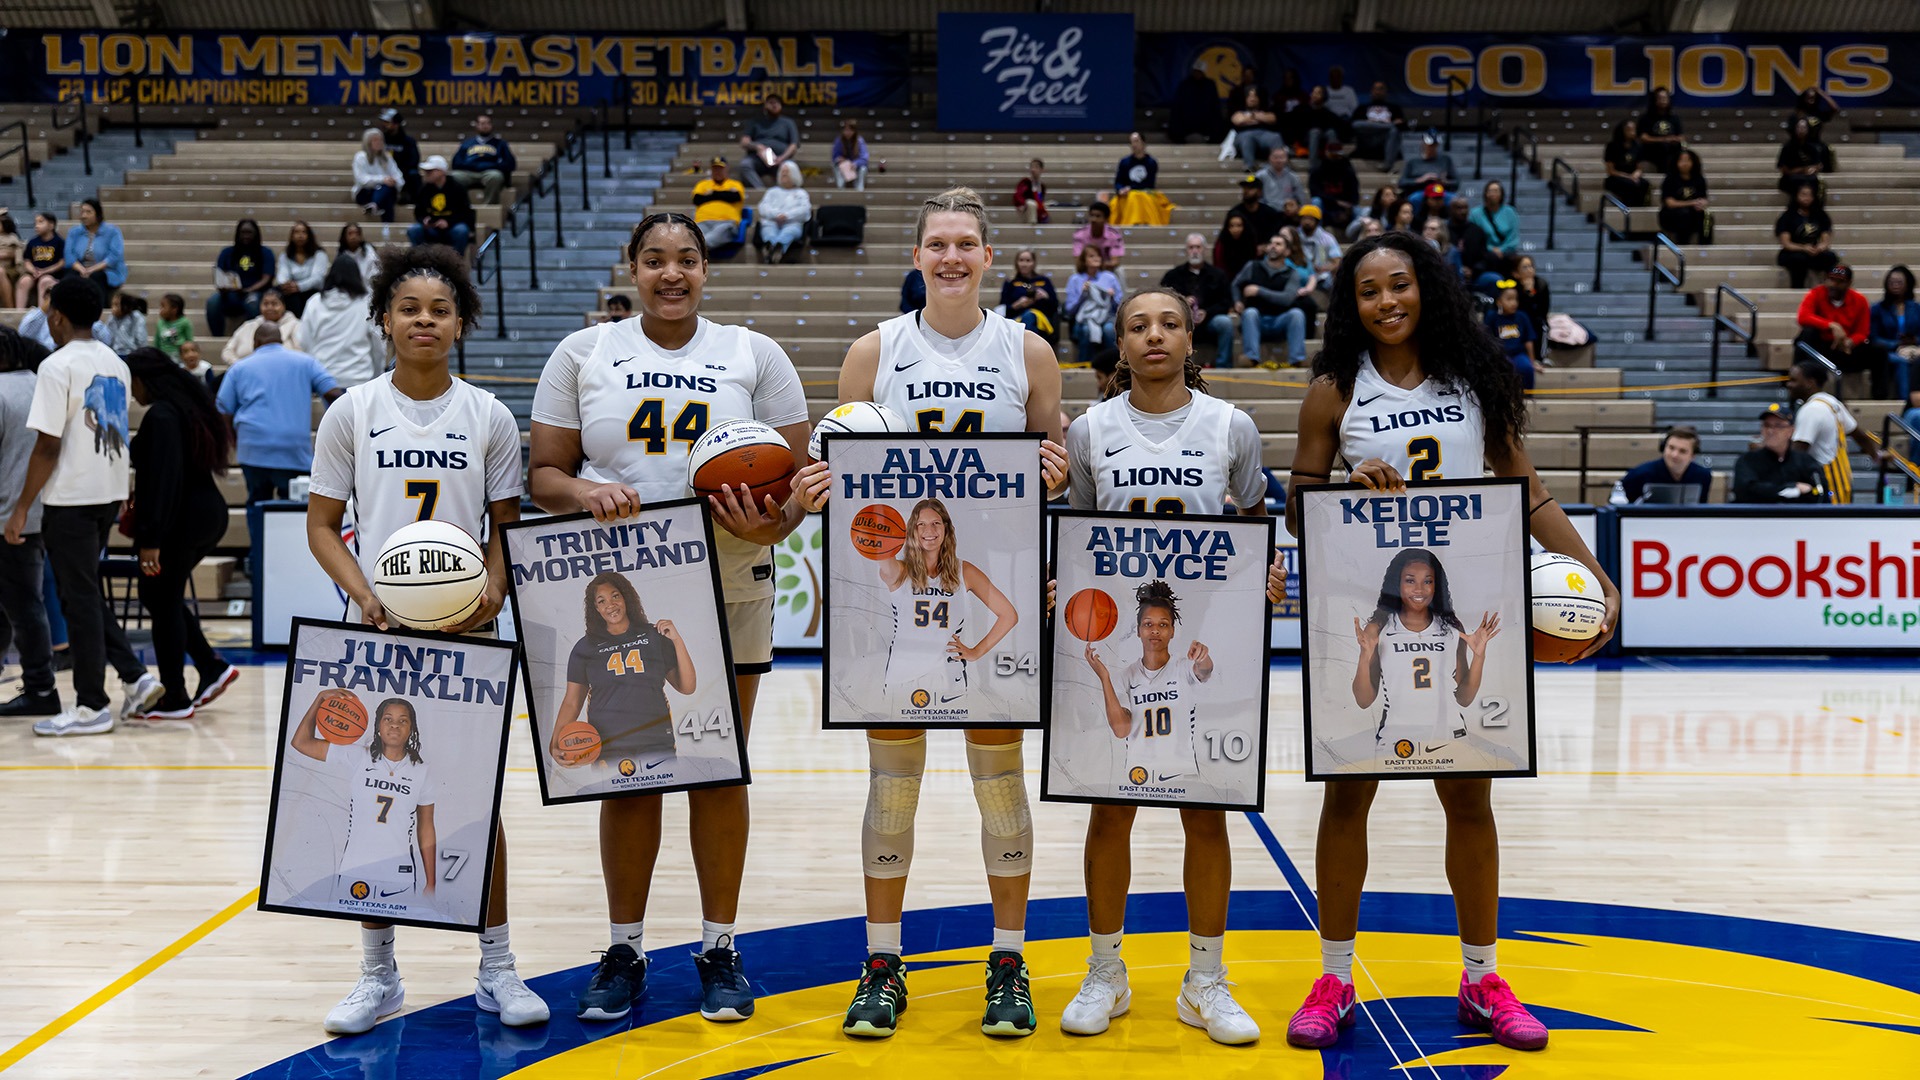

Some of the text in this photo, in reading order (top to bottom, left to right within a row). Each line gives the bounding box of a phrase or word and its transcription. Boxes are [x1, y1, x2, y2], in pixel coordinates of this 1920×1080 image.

[42, 34, 854, 77] LION MEN'S BASKETBALL
[980, 26, 1083, 80] Fix &
[1405, 45, 1893, 97] GO LIONS
[138, 80, 308, 105] CHAMPIONSHIPS
[339, 80, 351, 105] 7
[358, 80, 416, 105] NCAA
[423, 80, 579, 106] TOURNAMENTS
[631, 81, 658, 106] 30
[666, 81, 838, 106] ALL-AMERICANS
[997, 65, 1091, 112] Feed
[626, 372, 717, 393] LIONS
[906, 381, 996, 401] LIONS
[626, 397, 711, 456] 44
[1369, 405, 1465, 433] LIONS
[707, 431, 729, 446] #44
[376, 450, 468, 470] LIONS
[881, 447, 986, 473] ALVA
[1406, 435, 1443, 480] 2
[841, 472, 1025, 499] HEDRICH
[1112, 467, 1203, 488] LIONS
[405, 480, 440, 522] 7
[1340, 494, 1482, 524] KEIORI
[536, 519, 673, 558] TRINITY
[854, 516, 891, 533] Wilson
[1373, 521, 1451, 548] LEE
[855, 535, 883, 549] NCAA
[1086, 526, 1236, 556] AHMYA
[382, 550, 410, 576] THE
[511, 540, 707, 586] MORELAND
[1093, 551, 1228, 581] BOYCE
[1632, 540, 1920, 599] Brookshi
[914, 600, 949, 629] 54
[1560, 610, 1576, 623] #2
[1822, 604, 1884, 626] food
[338, 639, 465, 676] J'UNTI
[622, 639, 649, 649] TEXAS
[1393, 642, 1445, 653] LIONS
[607, 649, 645, 676] 44
[997, 652, 1038, 676] 54
[1412, 657, 1432, 690] 2
[294, 659, 506, 706] FRANKLIN
[328, 699, 361, 721] Wilson
[1133, 690, 1179, 705] LIONS
[324, 714, 350, 732] NCAA
[678, 706, 733, 741] 44
[1144, 706, 1172, 738] 10
[1481, 696, 1509, 728] 2
[1204, 730, 1252, 762] 10
[365, 778, 411, 795] LIONS
[376, 794, 394, 824] 7
[441, 849, 470, 881] 7
[360, 901, 387, 909] TEXAS
